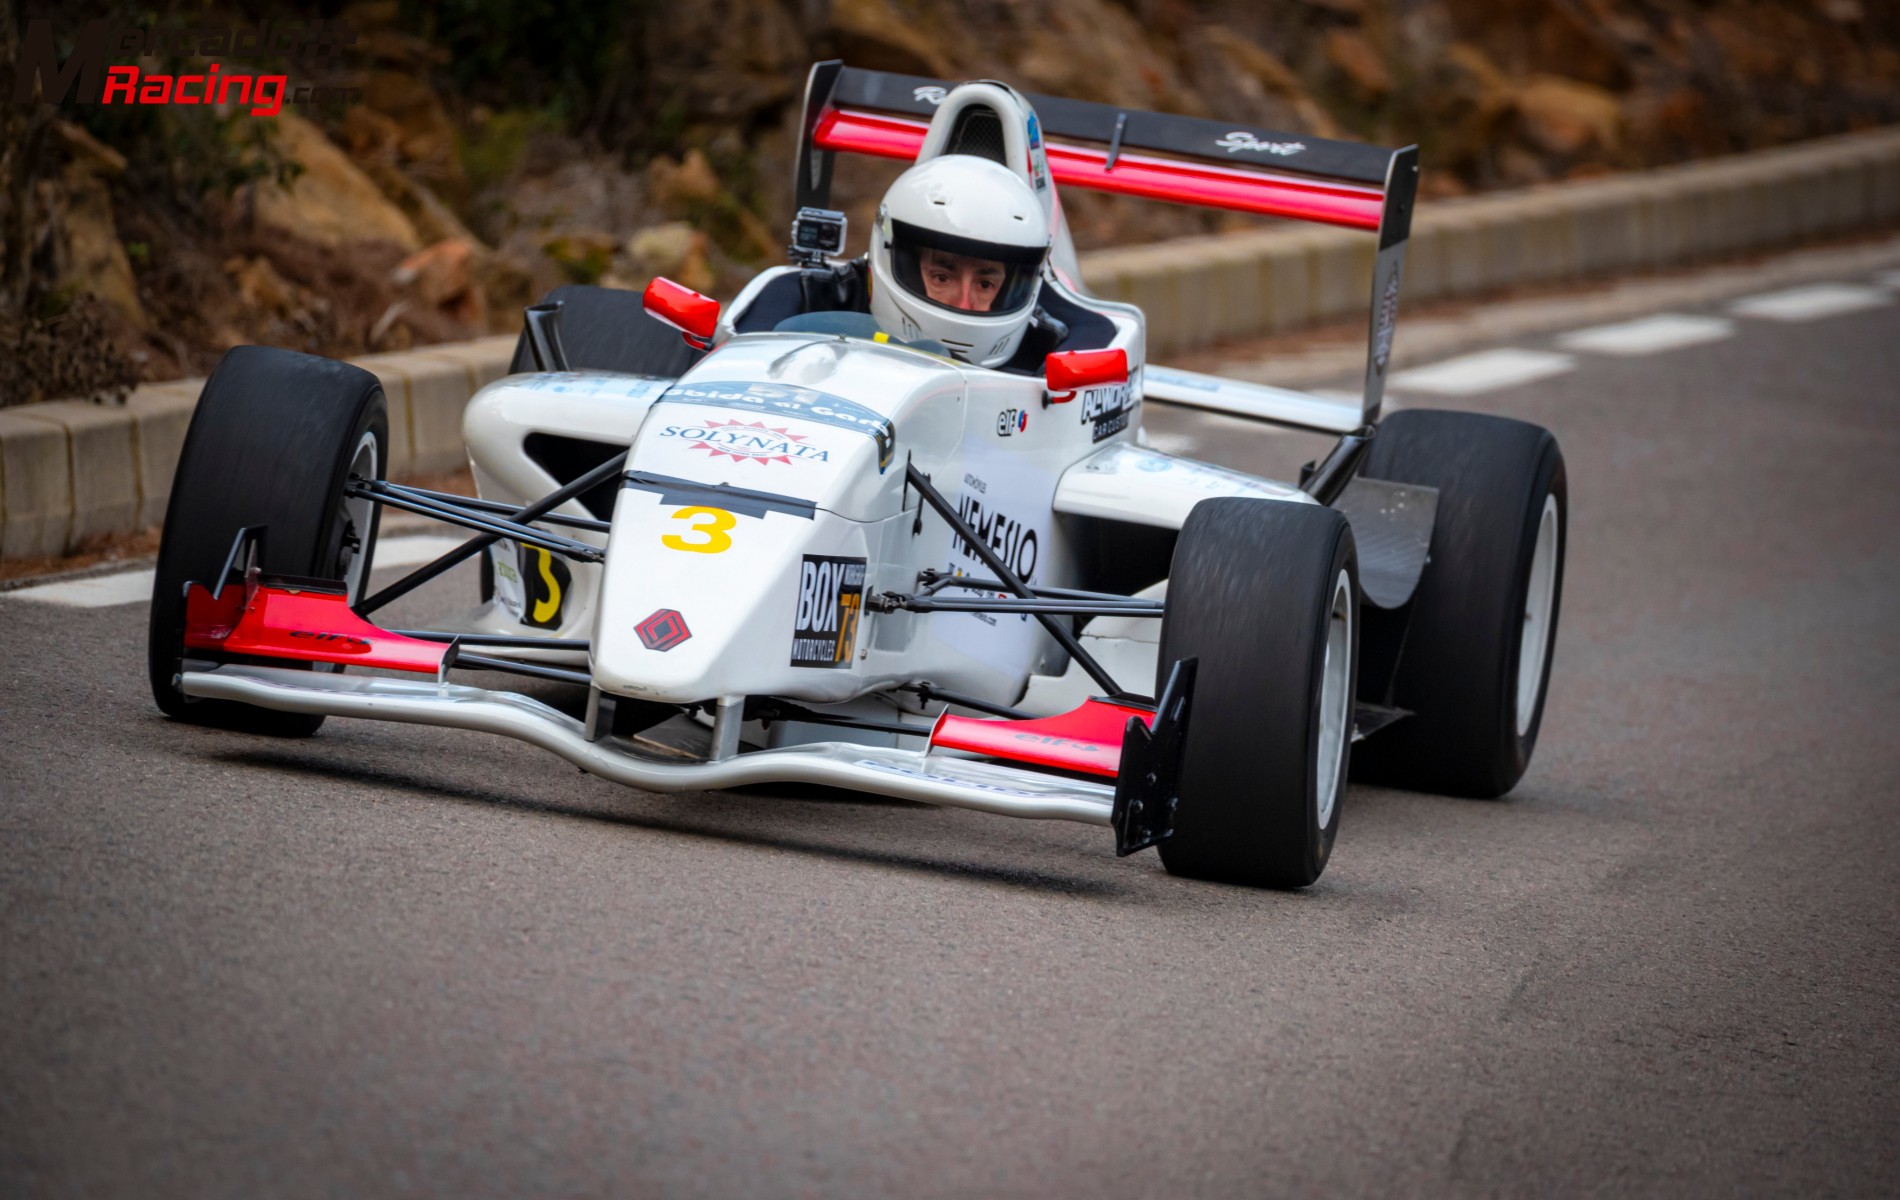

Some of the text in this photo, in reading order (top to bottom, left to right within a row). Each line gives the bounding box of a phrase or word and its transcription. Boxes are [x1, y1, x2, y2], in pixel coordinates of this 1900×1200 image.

[1215, 132, 1306, 155] Sport
[996, 408, 1017, 437] elf
[660, 425, 829, 462] SOLYNATA
[661, 505, 737, 554] 3
[796, 561, 846, 632] BOX
[1014, 733, 1073, 746] elf
